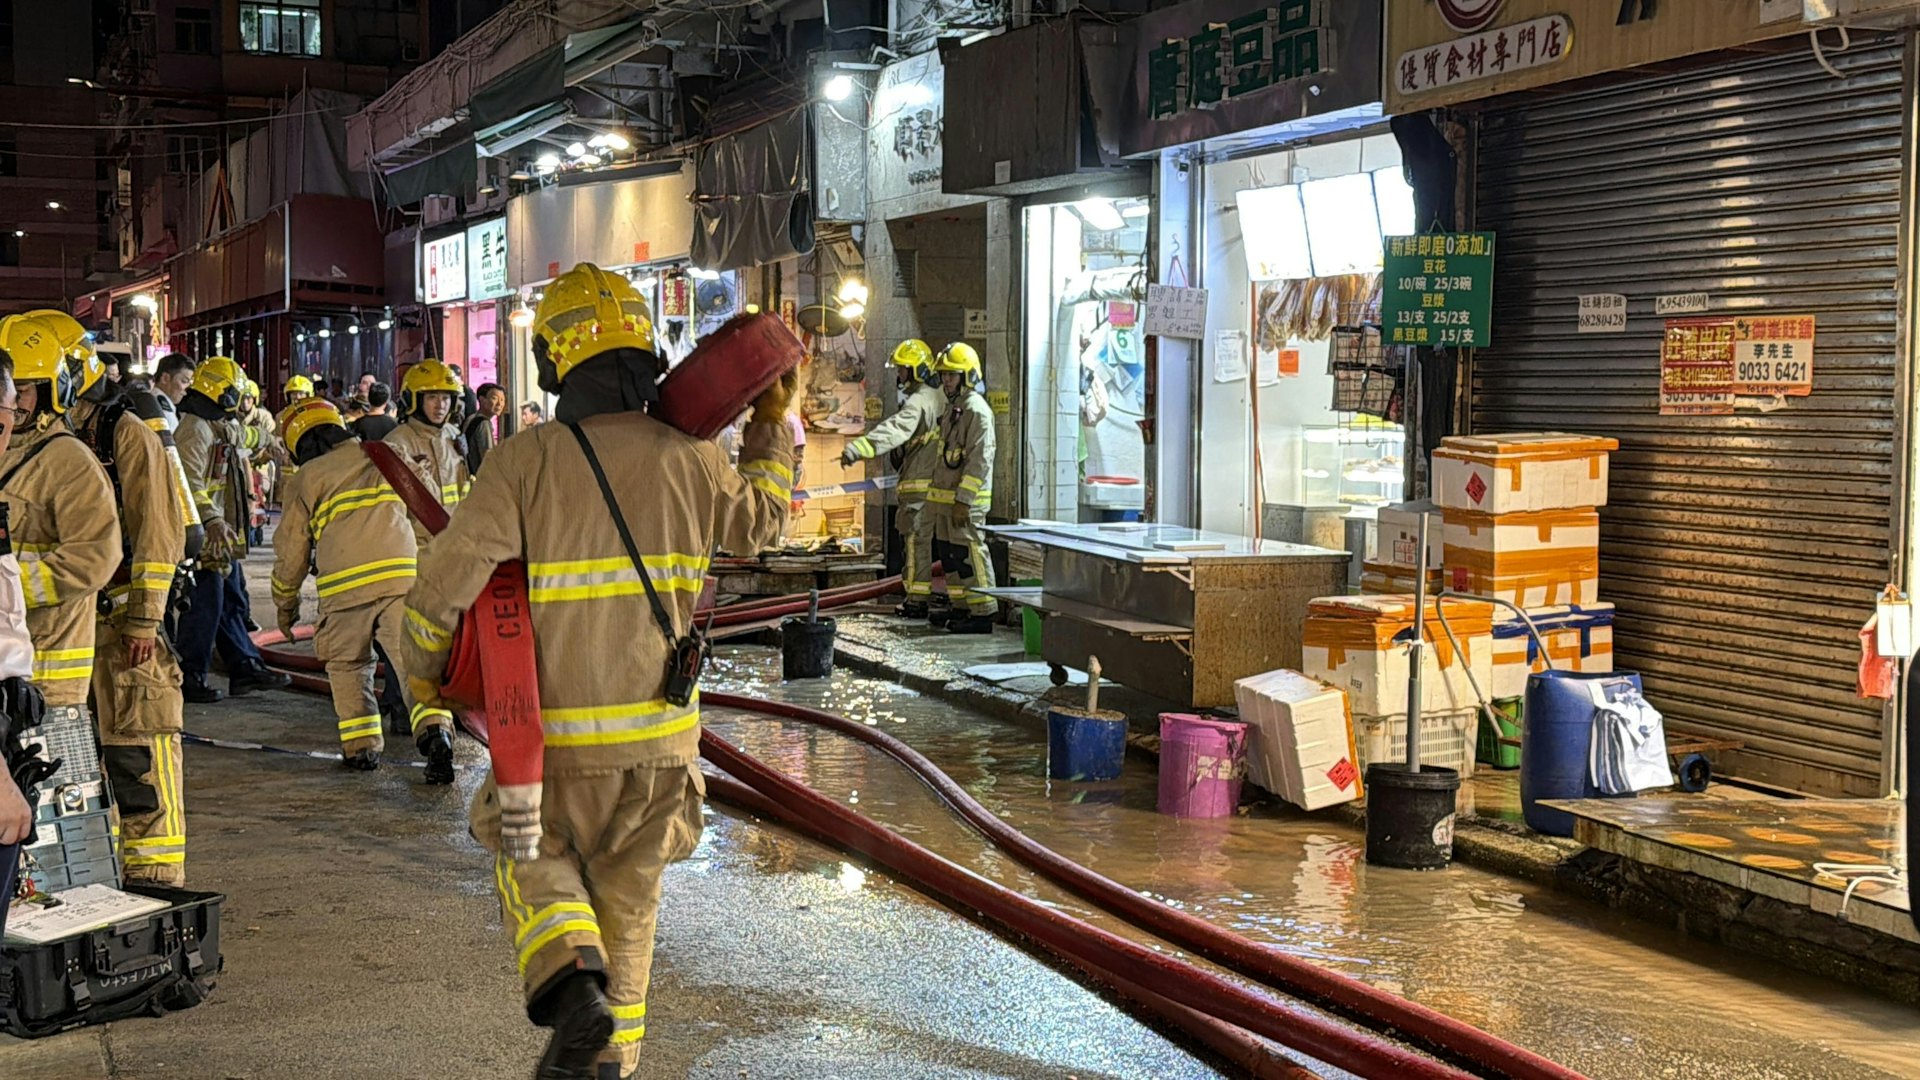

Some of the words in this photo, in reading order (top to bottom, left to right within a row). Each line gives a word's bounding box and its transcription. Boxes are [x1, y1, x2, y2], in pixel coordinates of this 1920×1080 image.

[1400, 20, 1563, 90] 優質食材專門店
[1422, 259, 1446, 273] 豆花
[1398, 276, 1427, 292] 10/碗
[1434, 276, 1472, 292] 25/3碗
[1422, 293, 1445, 307] 豆漿
[1397, 310, 1425, 325] 13/支
[1432, 310, 1470, 326] 25/2支
[1580, 313, 1624, 327] 68280428
[23, 331, 43, 349] TST
[1116, 329, 1129, 349] 6
[1440, 328, 1474, 344] 15/支
[1753, 343, 1793, 359] 李先生
[1739, 362, 1770, 381] 9033
[1775, 362, 1806, 381] 6421
